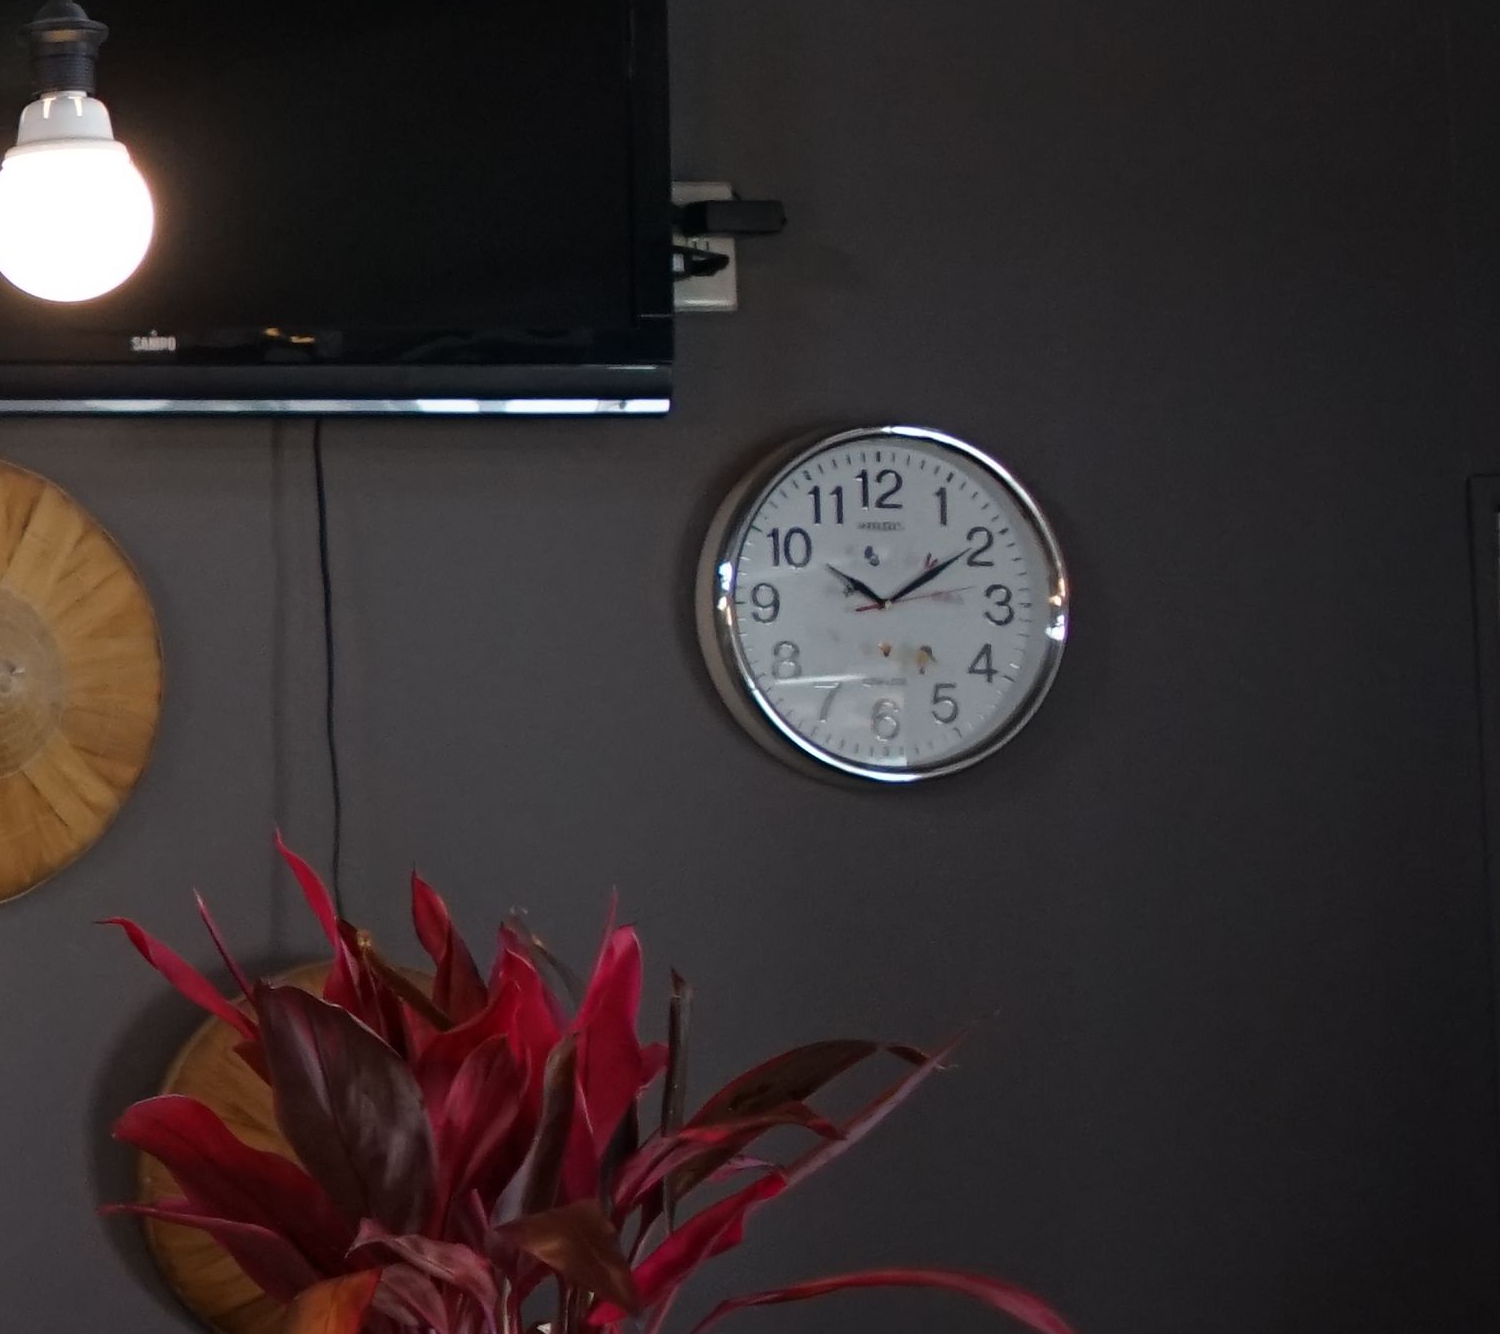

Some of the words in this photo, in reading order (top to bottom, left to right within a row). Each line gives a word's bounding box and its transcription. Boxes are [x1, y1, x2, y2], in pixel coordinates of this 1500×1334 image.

[130, 335, 177, 352] SAMPO
[808, 484, 845, 525] 11
[854, 468, 904, 510] 12
[934, 486, 948, 527] 1
[766, 526, 813, 569] 10
[965, 525, 995, 568] 2
[749, 581, 781, 624] 9
[984, 583, 1015, 626] 3
[770, 640, 802, 680] 8
[967, 642, 999, 684] 4
[812, 680, 842, 723] 7
[870, 697, 901, 743] 6
[930, 682, 959, 724] 5
